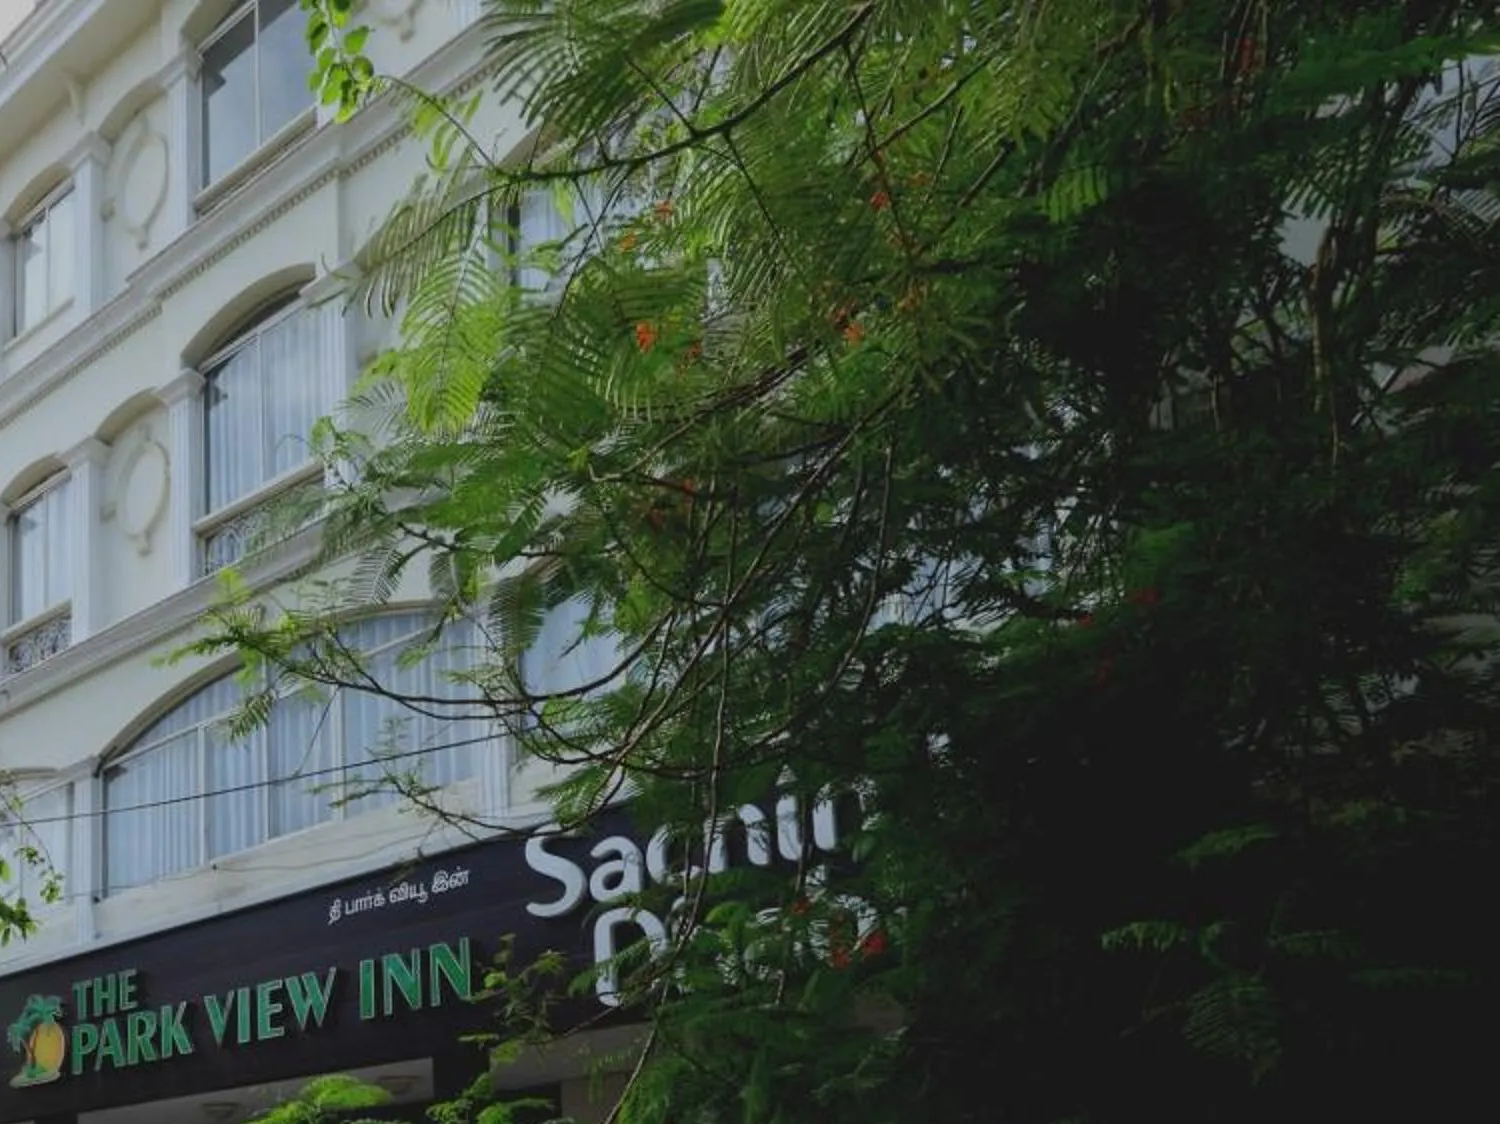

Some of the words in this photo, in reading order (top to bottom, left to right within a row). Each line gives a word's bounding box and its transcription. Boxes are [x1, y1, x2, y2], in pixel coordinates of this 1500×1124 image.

[71, 1001, 194, 1076] PARK
[203, 966, 337, 1047] VIEW
[358, 936, 472, 1020] INN
[72, 968, 139, 1020] THE
